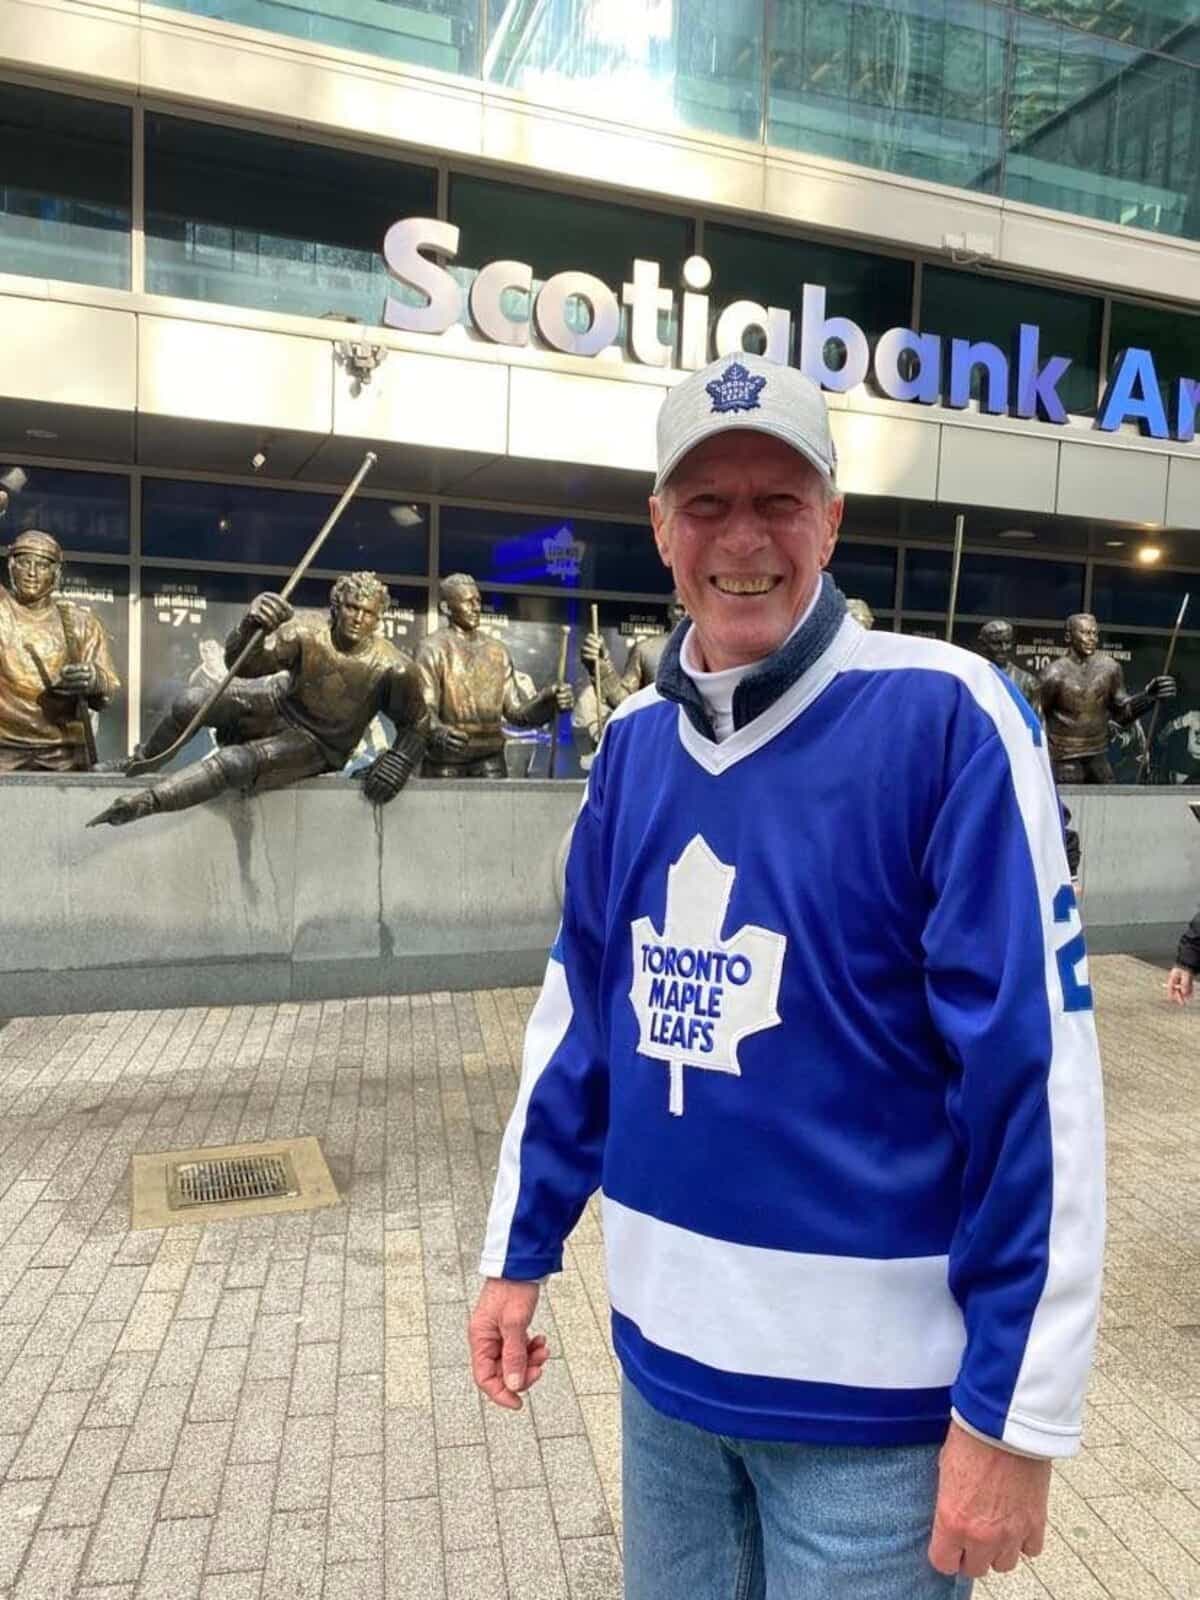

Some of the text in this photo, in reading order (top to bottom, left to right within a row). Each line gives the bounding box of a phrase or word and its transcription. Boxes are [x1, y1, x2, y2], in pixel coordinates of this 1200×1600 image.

[383, 216, 1072, 425] Scotiabank
[641, 944, 751, 986] TORONTO
[648, 977, 724, 1019] MAPLE
[650, 1012, 715, 1053] LEAFS
